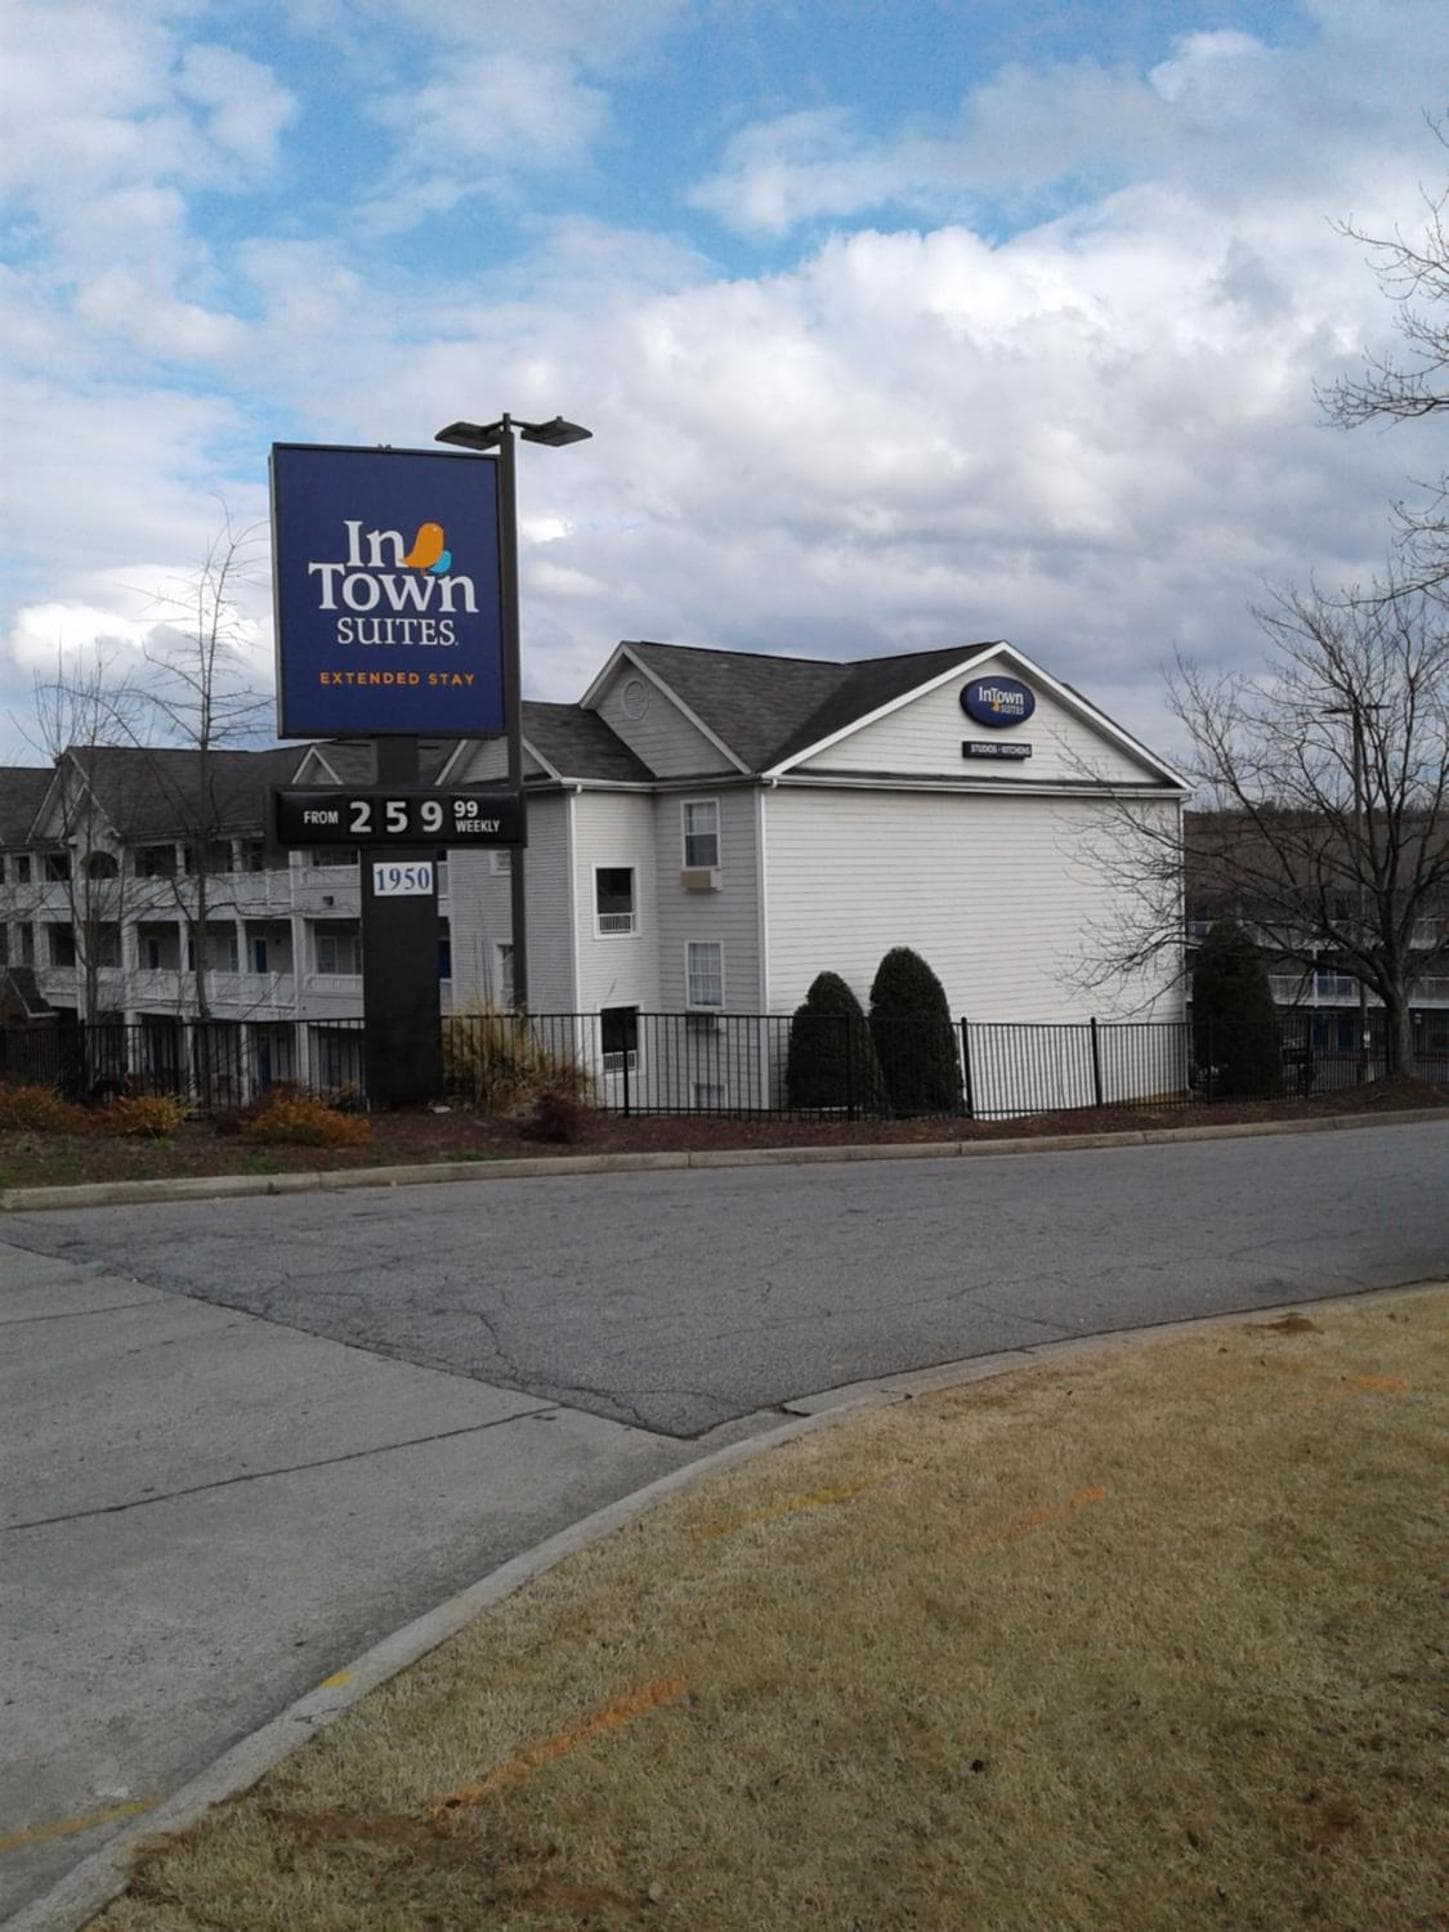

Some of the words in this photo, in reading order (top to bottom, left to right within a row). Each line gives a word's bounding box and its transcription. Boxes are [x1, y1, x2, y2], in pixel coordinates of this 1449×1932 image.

[344, 520, 409, 568] In
[308, 562, 479, 613] Town
[337, 617, 455, 646] SUITES
[320, 672, 420, 685] EXTENDED
[428, 673, 475, 685] STAY
[979, 686, 1024, 705] InTown
[304, 811, 339, 824] FROM
[454, 801, 478, 817] 99
[456, 820, 500, 832] WEEKLY
[377, 867, 430, 890] 1950
